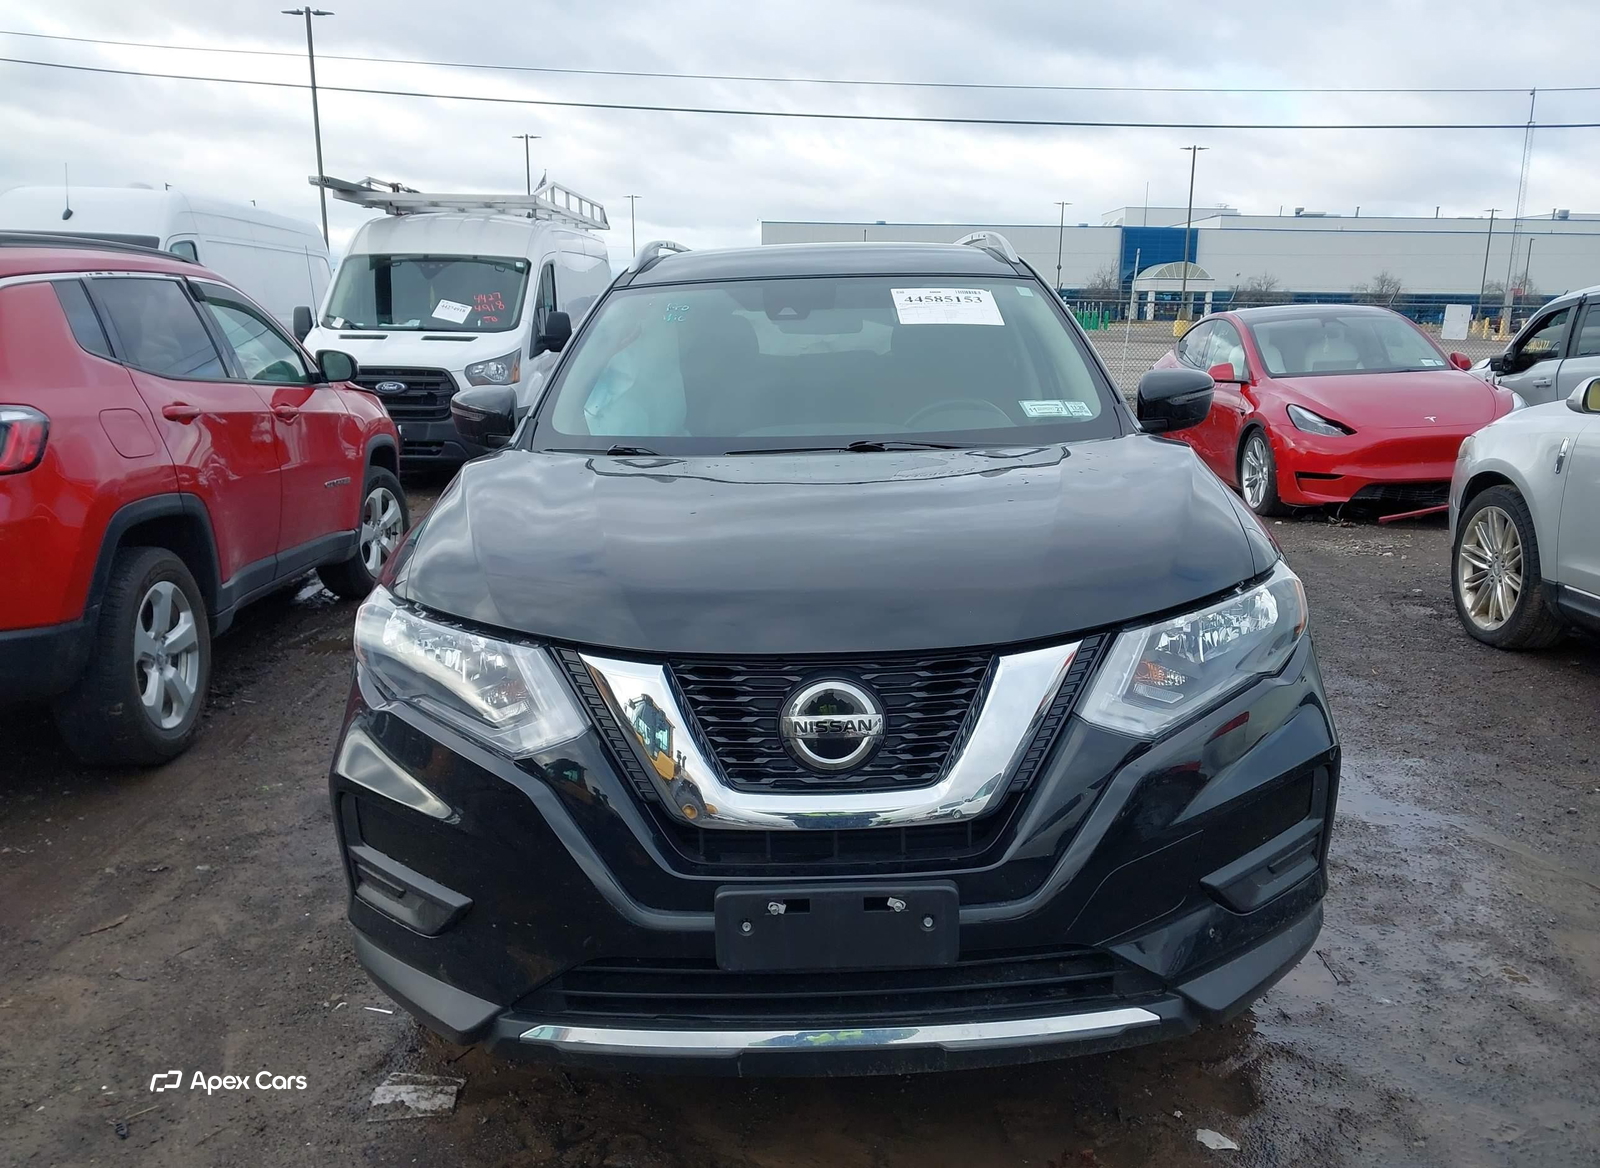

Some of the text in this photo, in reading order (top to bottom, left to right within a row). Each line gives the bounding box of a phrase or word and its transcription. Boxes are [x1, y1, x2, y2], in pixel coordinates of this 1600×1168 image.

[473, 292, 501, 304] 4427
[904, 295, 983, 304] 44585153
[474, 300, 505, 312] 4918
[793, 719, 872, 733] NISSAN
